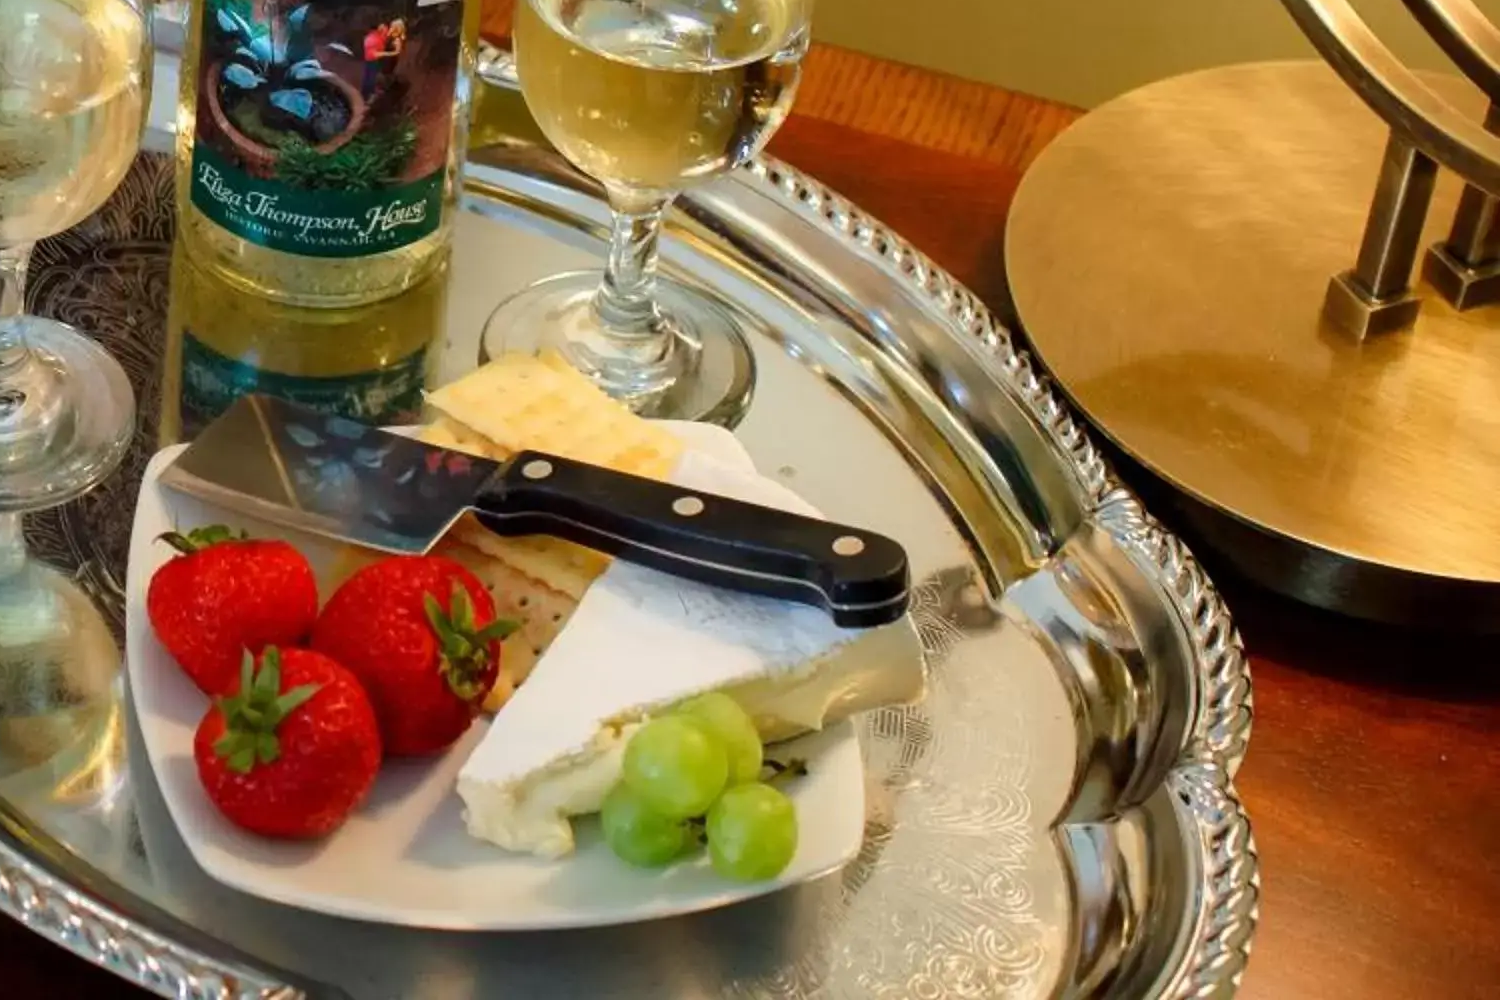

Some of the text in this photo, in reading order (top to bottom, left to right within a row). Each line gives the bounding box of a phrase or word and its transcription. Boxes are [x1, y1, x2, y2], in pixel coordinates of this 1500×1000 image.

[198, 161, 427, 237] Eliza Thompson House
